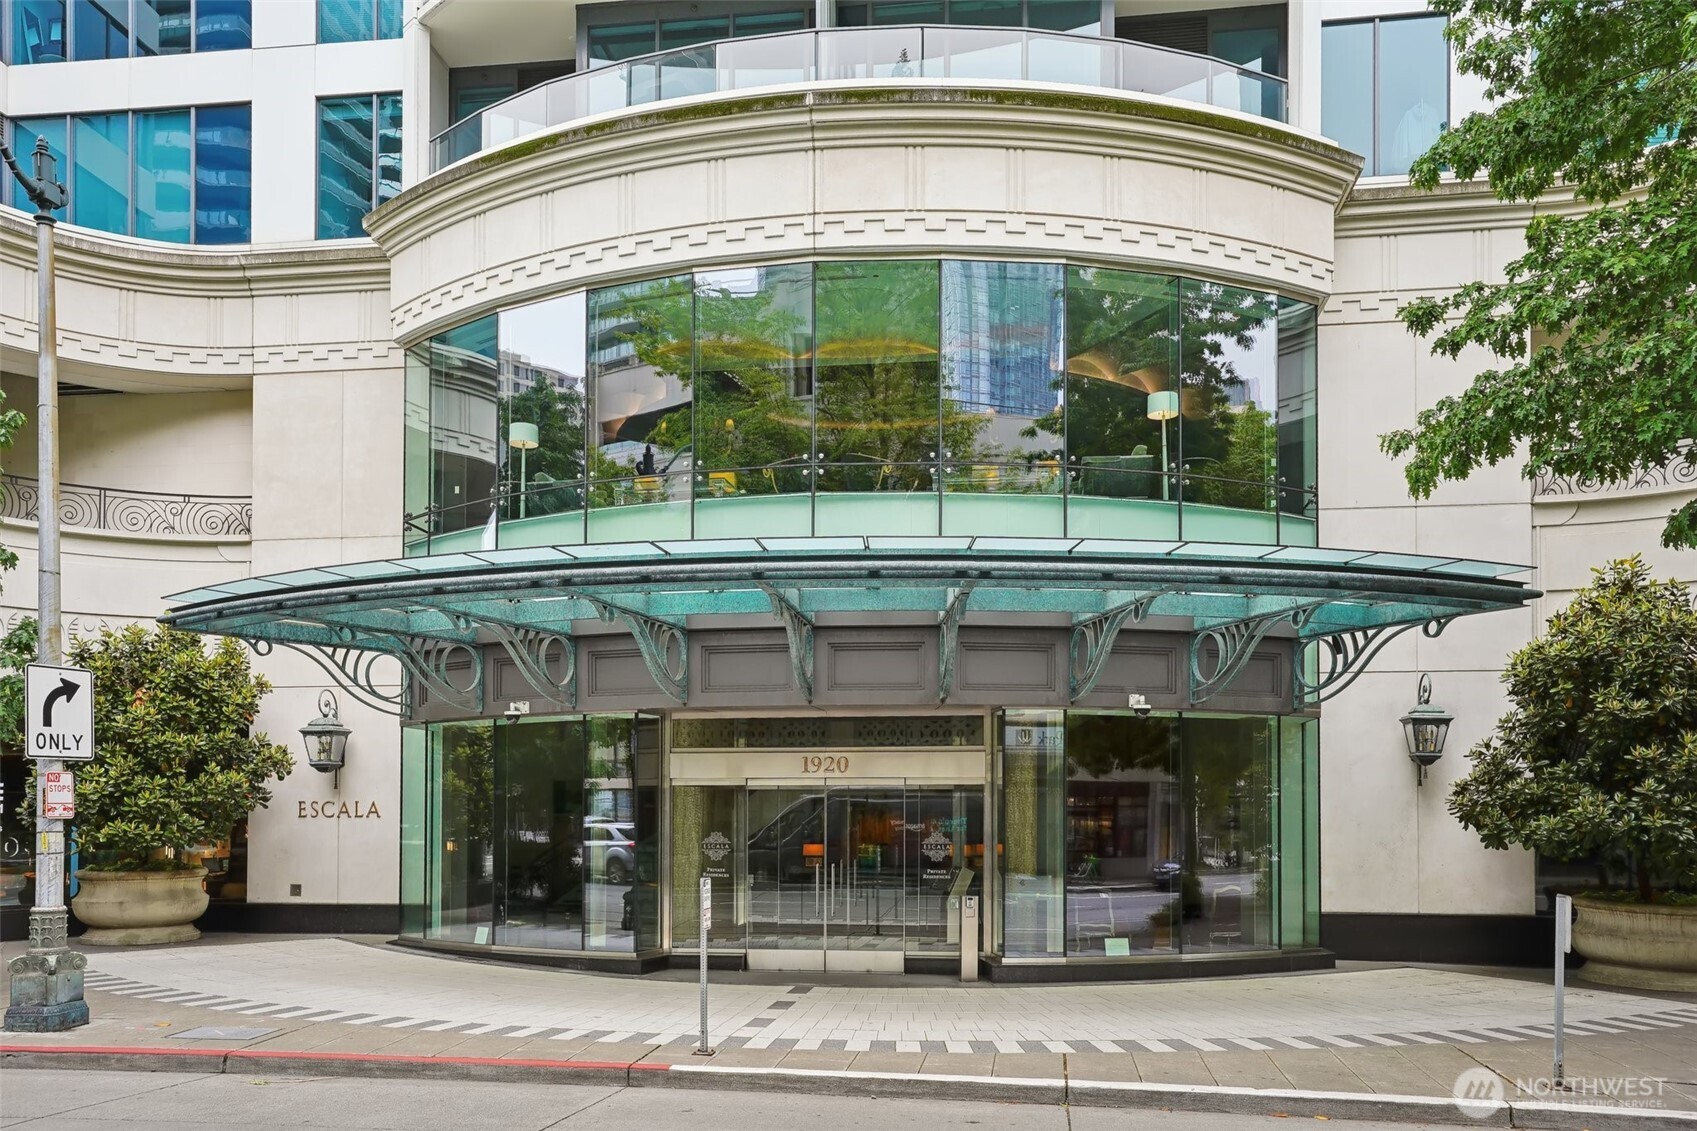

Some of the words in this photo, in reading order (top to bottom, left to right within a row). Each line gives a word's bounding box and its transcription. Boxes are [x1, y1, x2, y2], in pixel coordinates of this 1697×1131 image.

[36, 732, 84, 751] ONLY
[801, 756, 849, 773] 1920
[48, 773, 59, 782] NO
[49, 785, 71, 793] STOPS
[298, 800, 381, 818] ESCALA
